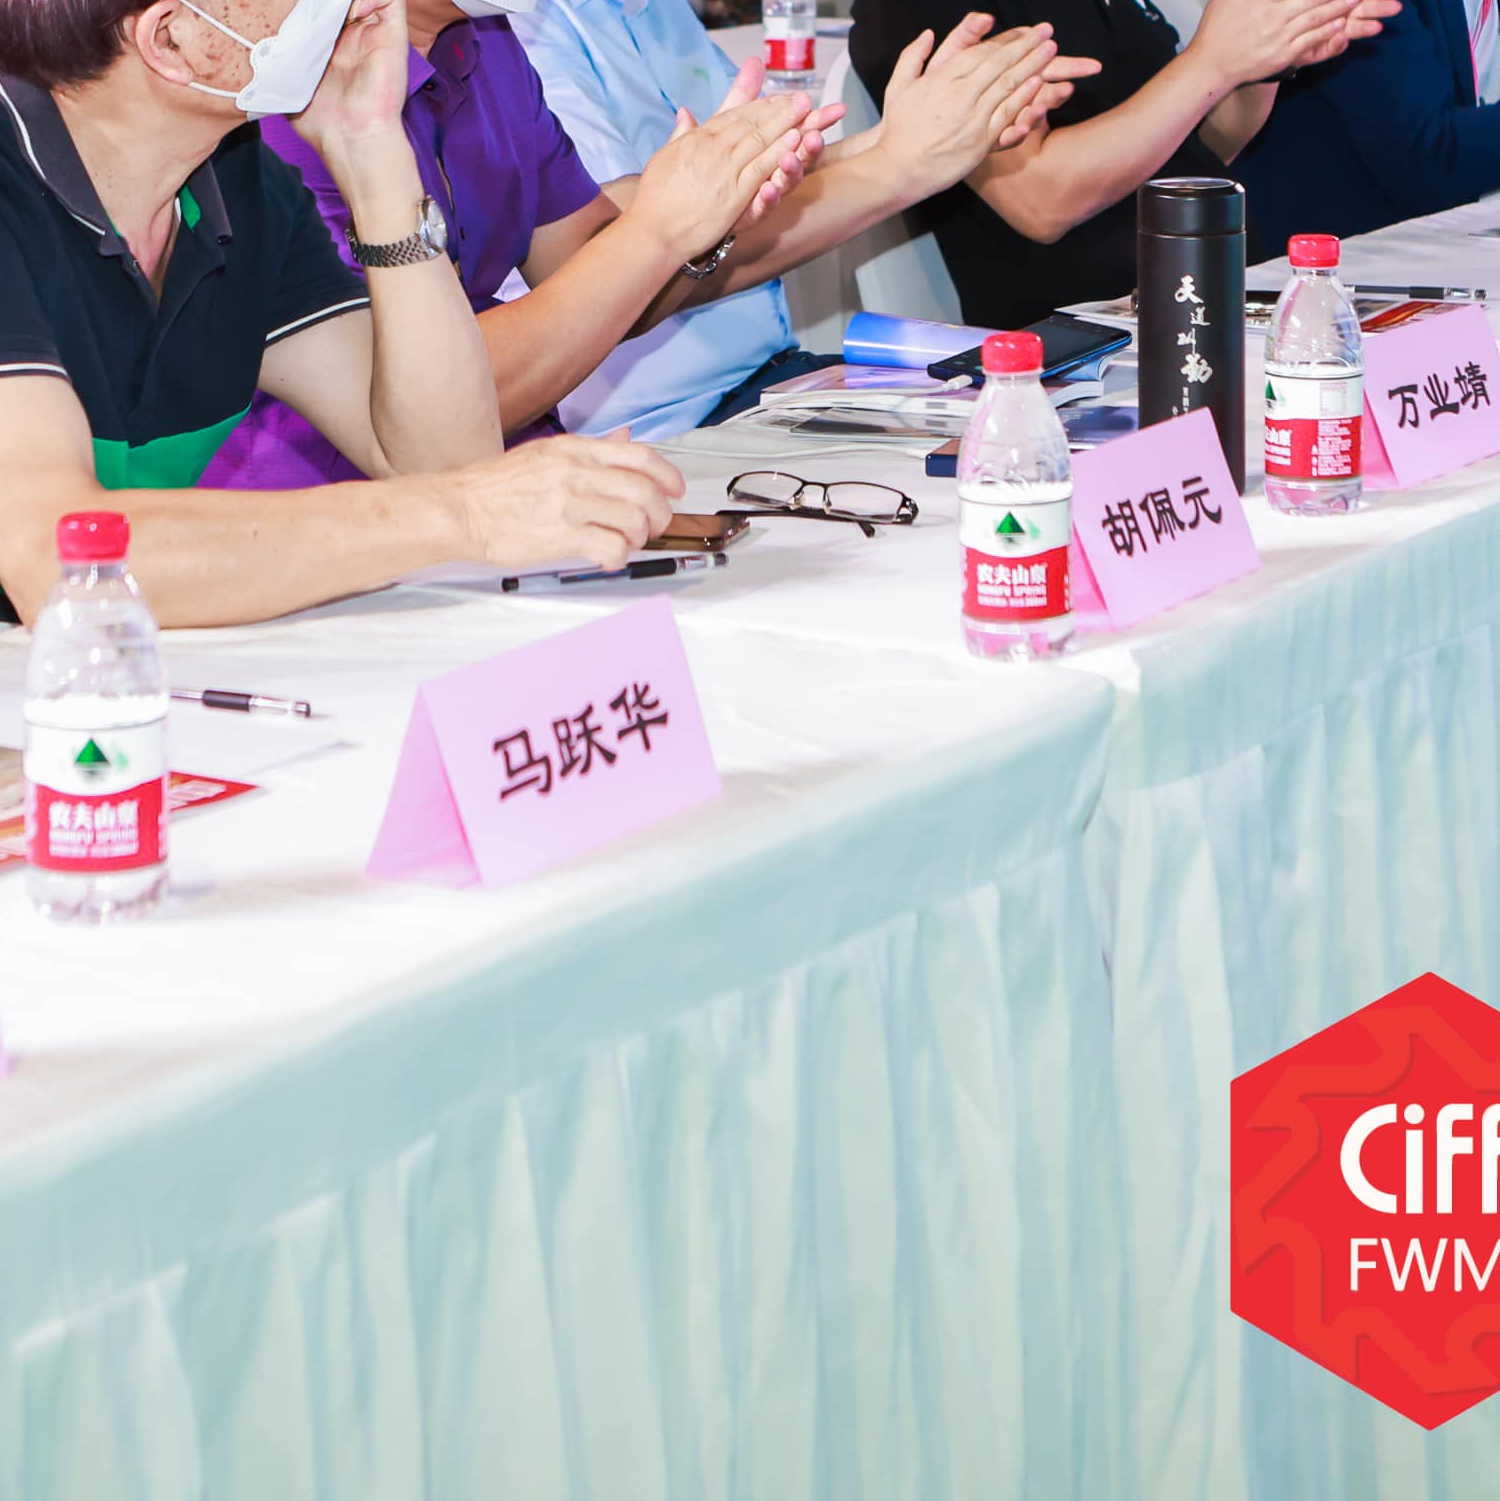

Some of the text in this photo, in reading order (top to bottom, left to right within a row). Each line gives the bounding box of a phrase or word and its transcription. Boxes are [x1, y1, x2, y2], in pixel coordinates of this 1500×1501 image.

[1387, 360, 1491, 429] 万业靖
[1102, 476, 1223, 558] 胡佩元
[977, 562, 1048, 586] 农夫山泉
[493, 681, 670, 802] 马跃华
